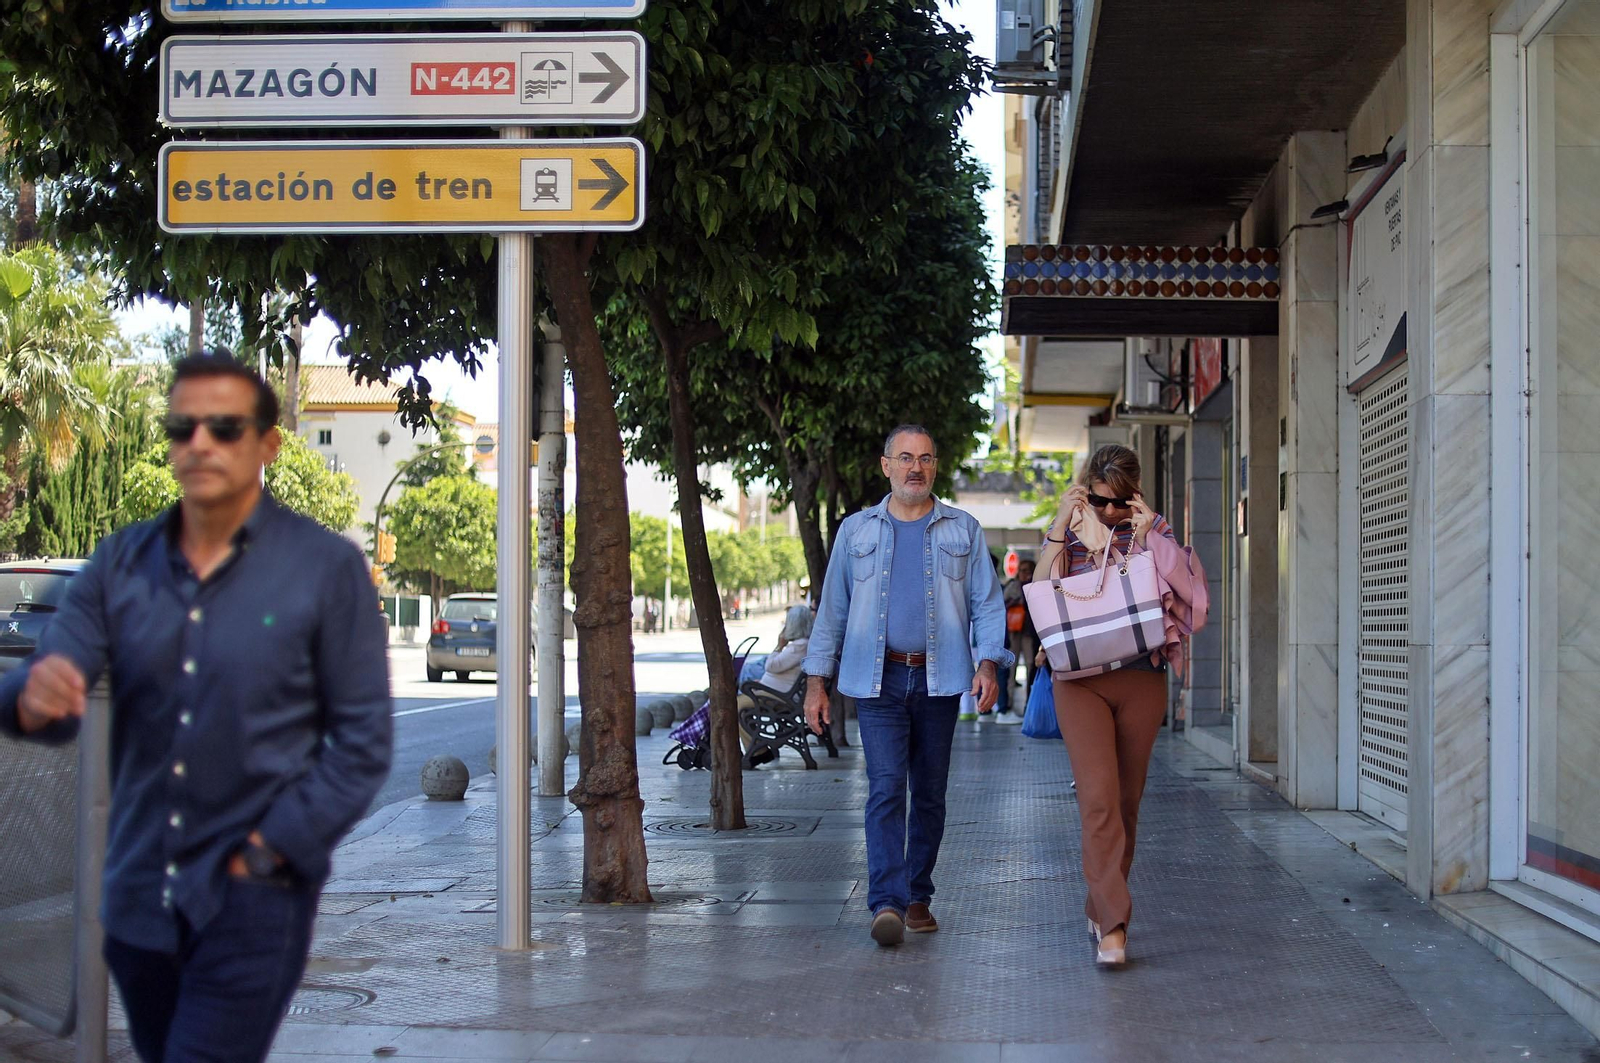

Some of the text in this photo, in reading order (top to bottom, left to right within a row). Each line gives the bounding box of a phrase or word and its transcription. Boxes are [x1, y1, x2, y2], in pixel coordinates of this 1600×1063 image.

[173, 62, 511, 98] MAZAGÓN N-442
[172, 171, 493, 201] estación de tren
